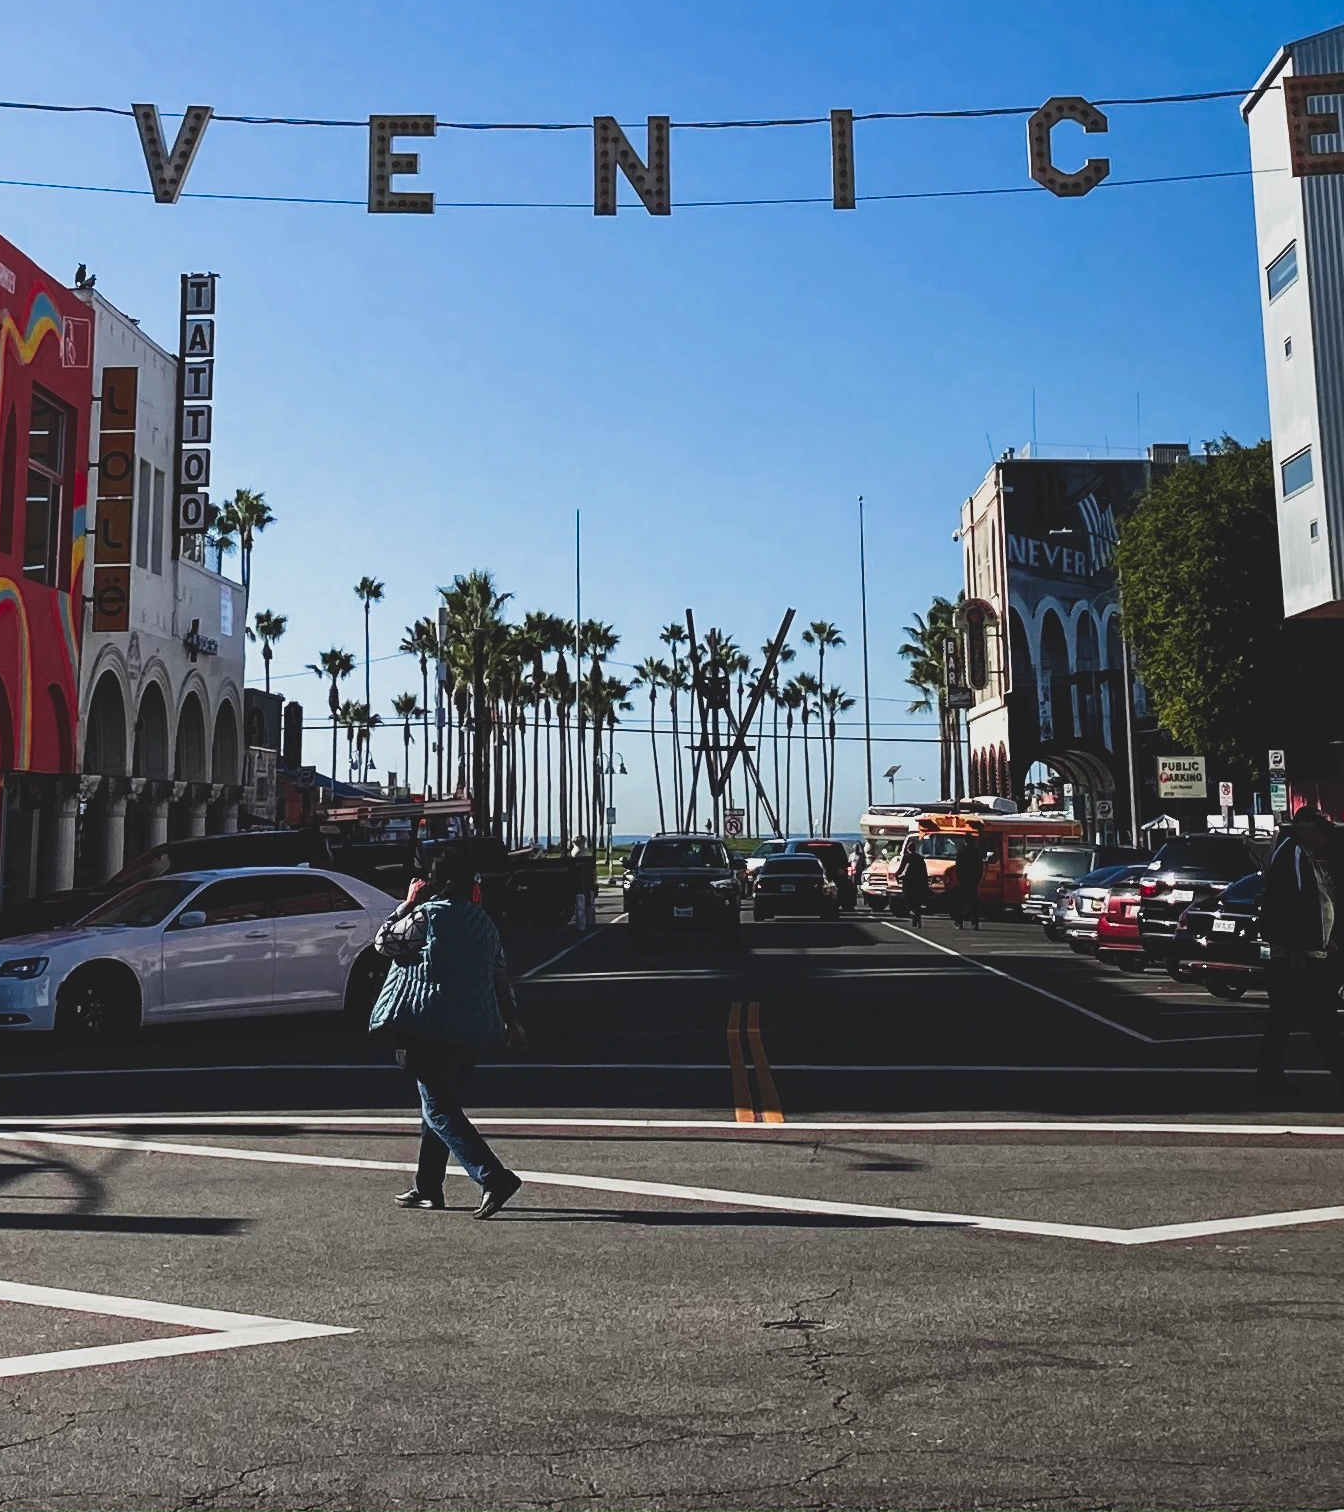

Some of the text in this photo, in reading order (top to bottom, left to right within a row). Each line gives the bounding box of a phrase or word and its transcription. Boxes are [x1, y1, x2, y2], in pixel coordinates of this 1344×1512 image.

[182, 281, 208, 526] TATTOO
[1007, 532, 1087, 577] NEVER
[947, 641, 957, 685] BAR
[1161, 761, 1200, 771] PUBLIC
